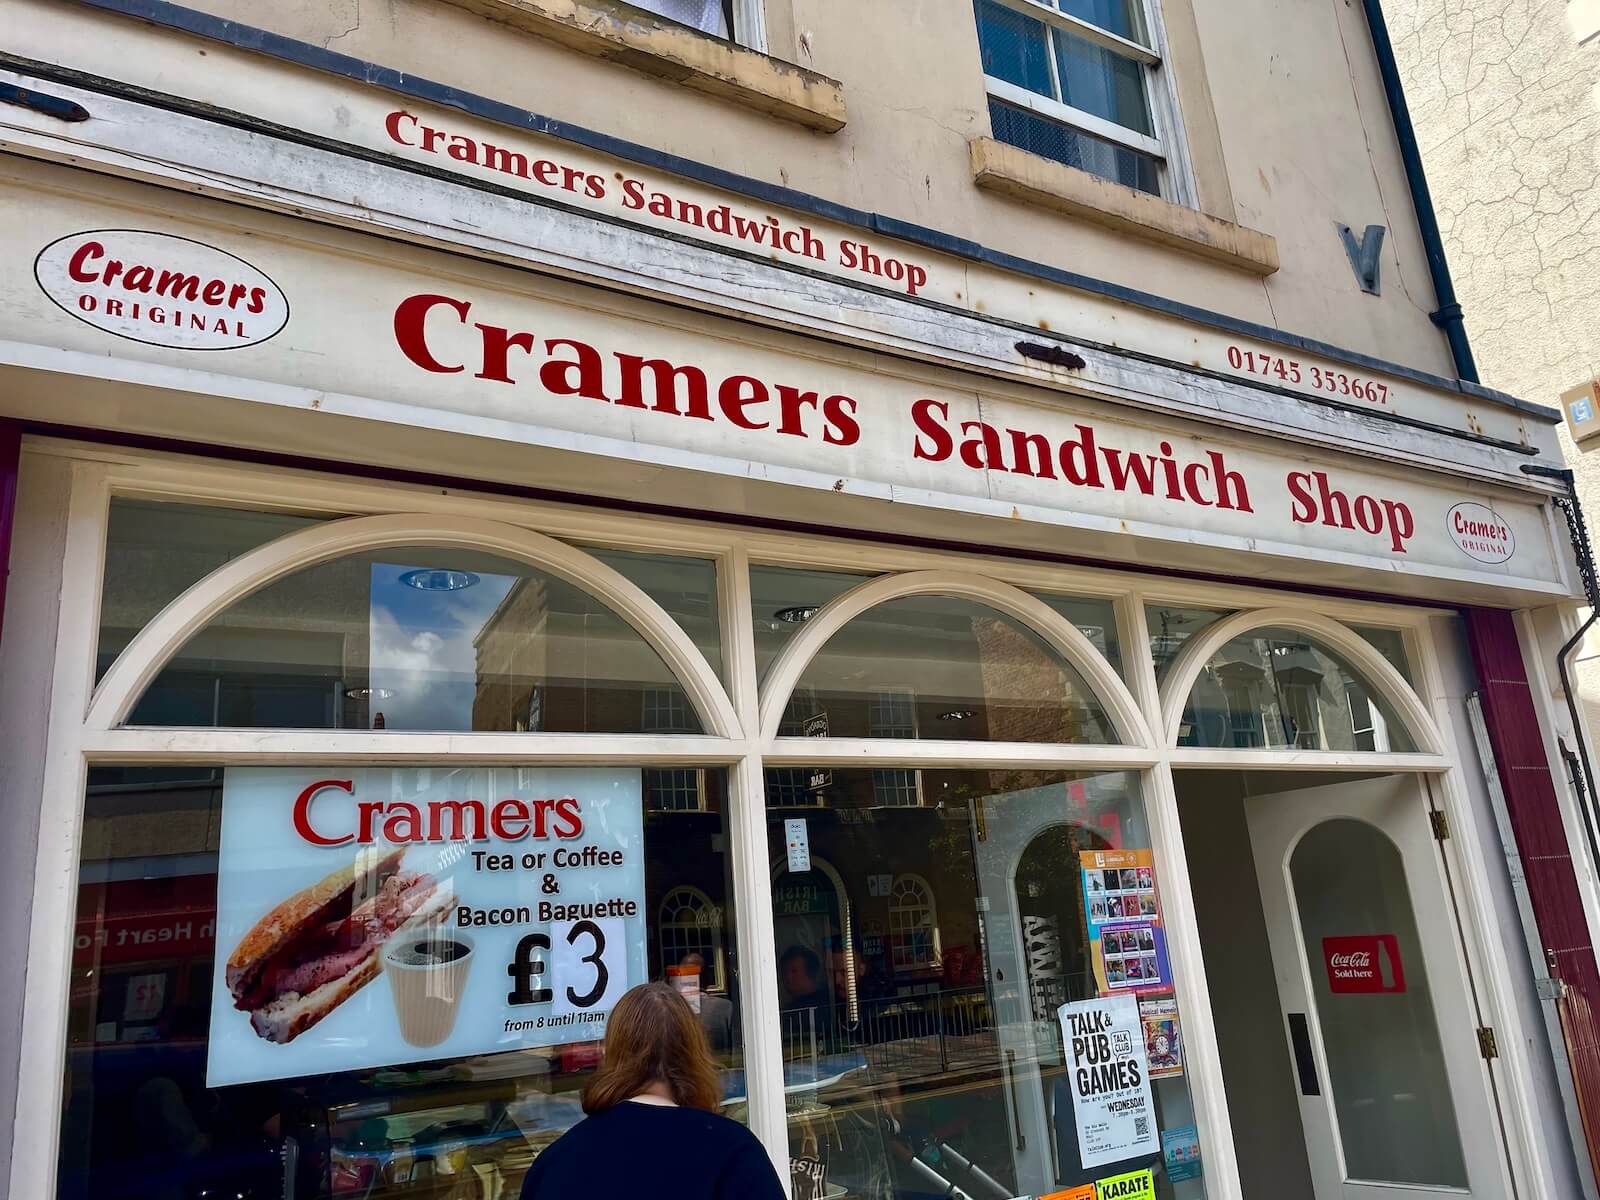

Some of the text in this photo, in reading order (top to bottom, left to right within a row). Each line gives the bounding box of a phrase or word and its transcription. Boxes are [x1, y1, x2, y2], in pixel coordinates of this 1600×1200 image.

[385, 111, 928, 296] Cramers Sandwich Shop
[68, 241, 266, 314] Cramers
[78, 294, 251, 339] ORIGINAL
[1227, 346, 1388, 405] 01745 353667
[393, 293, 1415, 554] Cramers Sandwich Shop
[1454, 511, 1507, 541] Cramers
[1462, 539, 1508, 555] ORIGINAL
[292, 779, 584, 846] Cramers
[471, 845, 624, 872] Tea or Coffee
[541, 873, 560, 894] &
[457, 898, 638, 927] Bacon Baguette
[507, 919, 609, 1008] £3
[1334, 968, 1373, 978] Sold here
[504, 1011, 605, 1032] from 8 until 11am
[1066, 1010, 1113, 1036] TALK &
[1072, 1034, 1111, 1067] PUB
[1113, 1032, 1129, 1043] TALK
[1114, 1042, 1130, 1055] CLUB
[1076, 1059, 1142, 1097] GAMES
[1107, 1095, 1145, 1113] WEDNESDAY
[1102, 1175, 1149, 1200] KARATE
